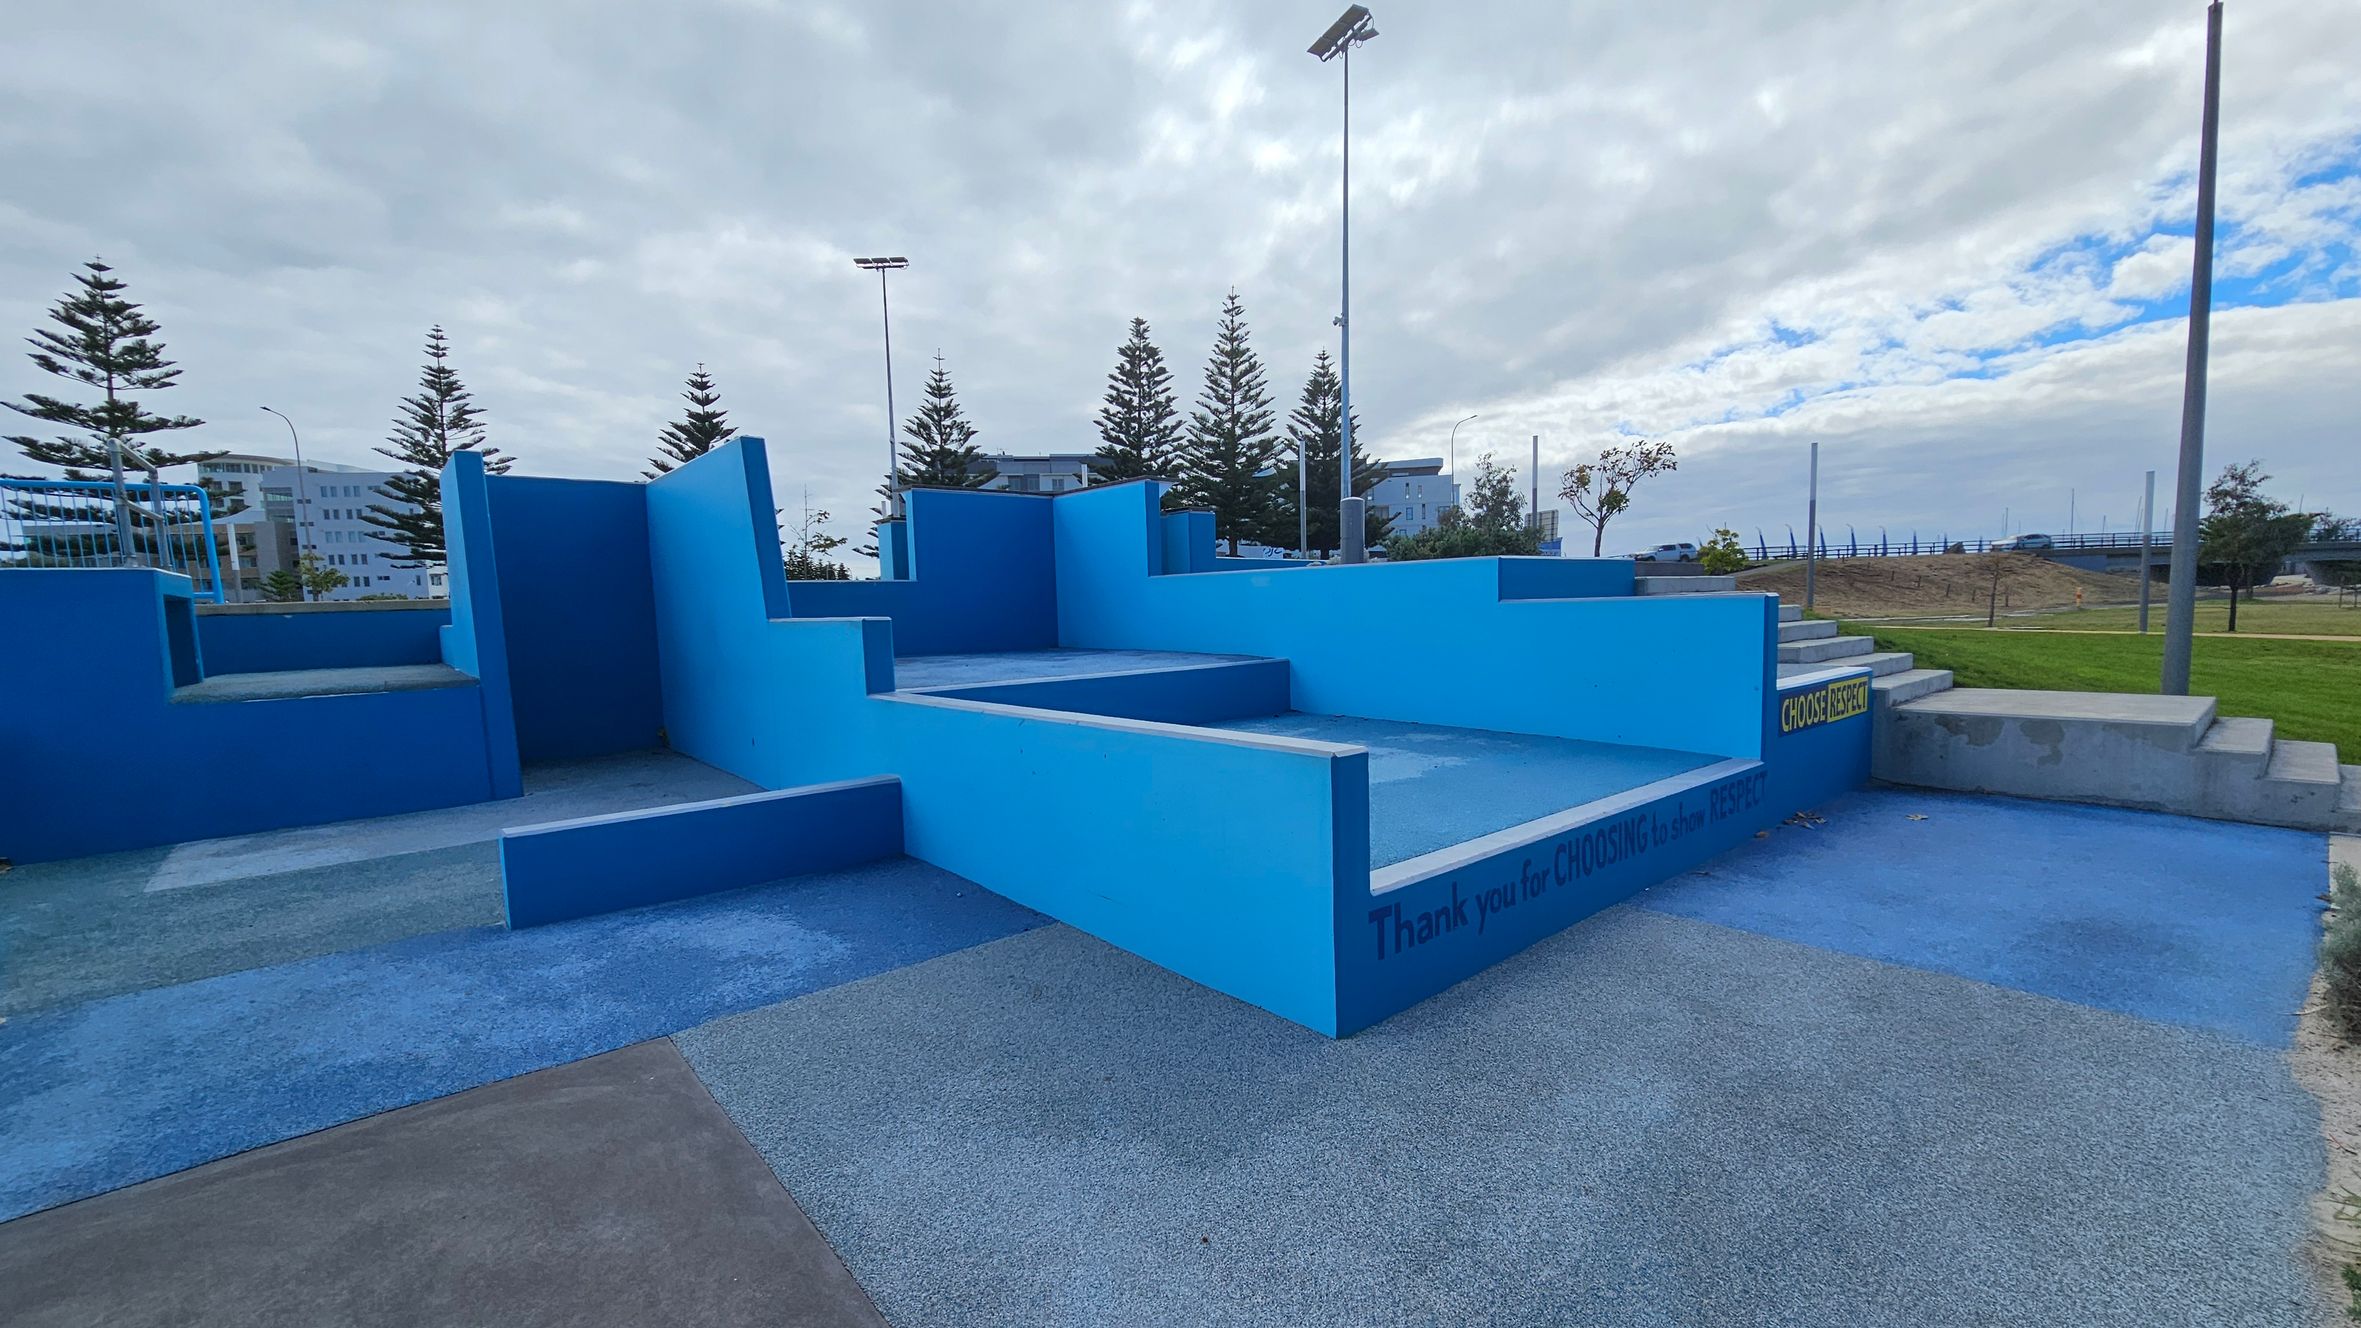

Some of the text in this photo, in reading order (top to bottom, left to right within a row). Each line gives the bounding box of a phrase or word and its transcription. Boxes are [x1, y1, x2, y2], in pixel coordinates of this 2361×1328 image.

[1782, 680, 1869, 733] CHOOSE RESPECT
[1368, 769, 1769, 961] Thank you for CHOOSING to show RESPECT
